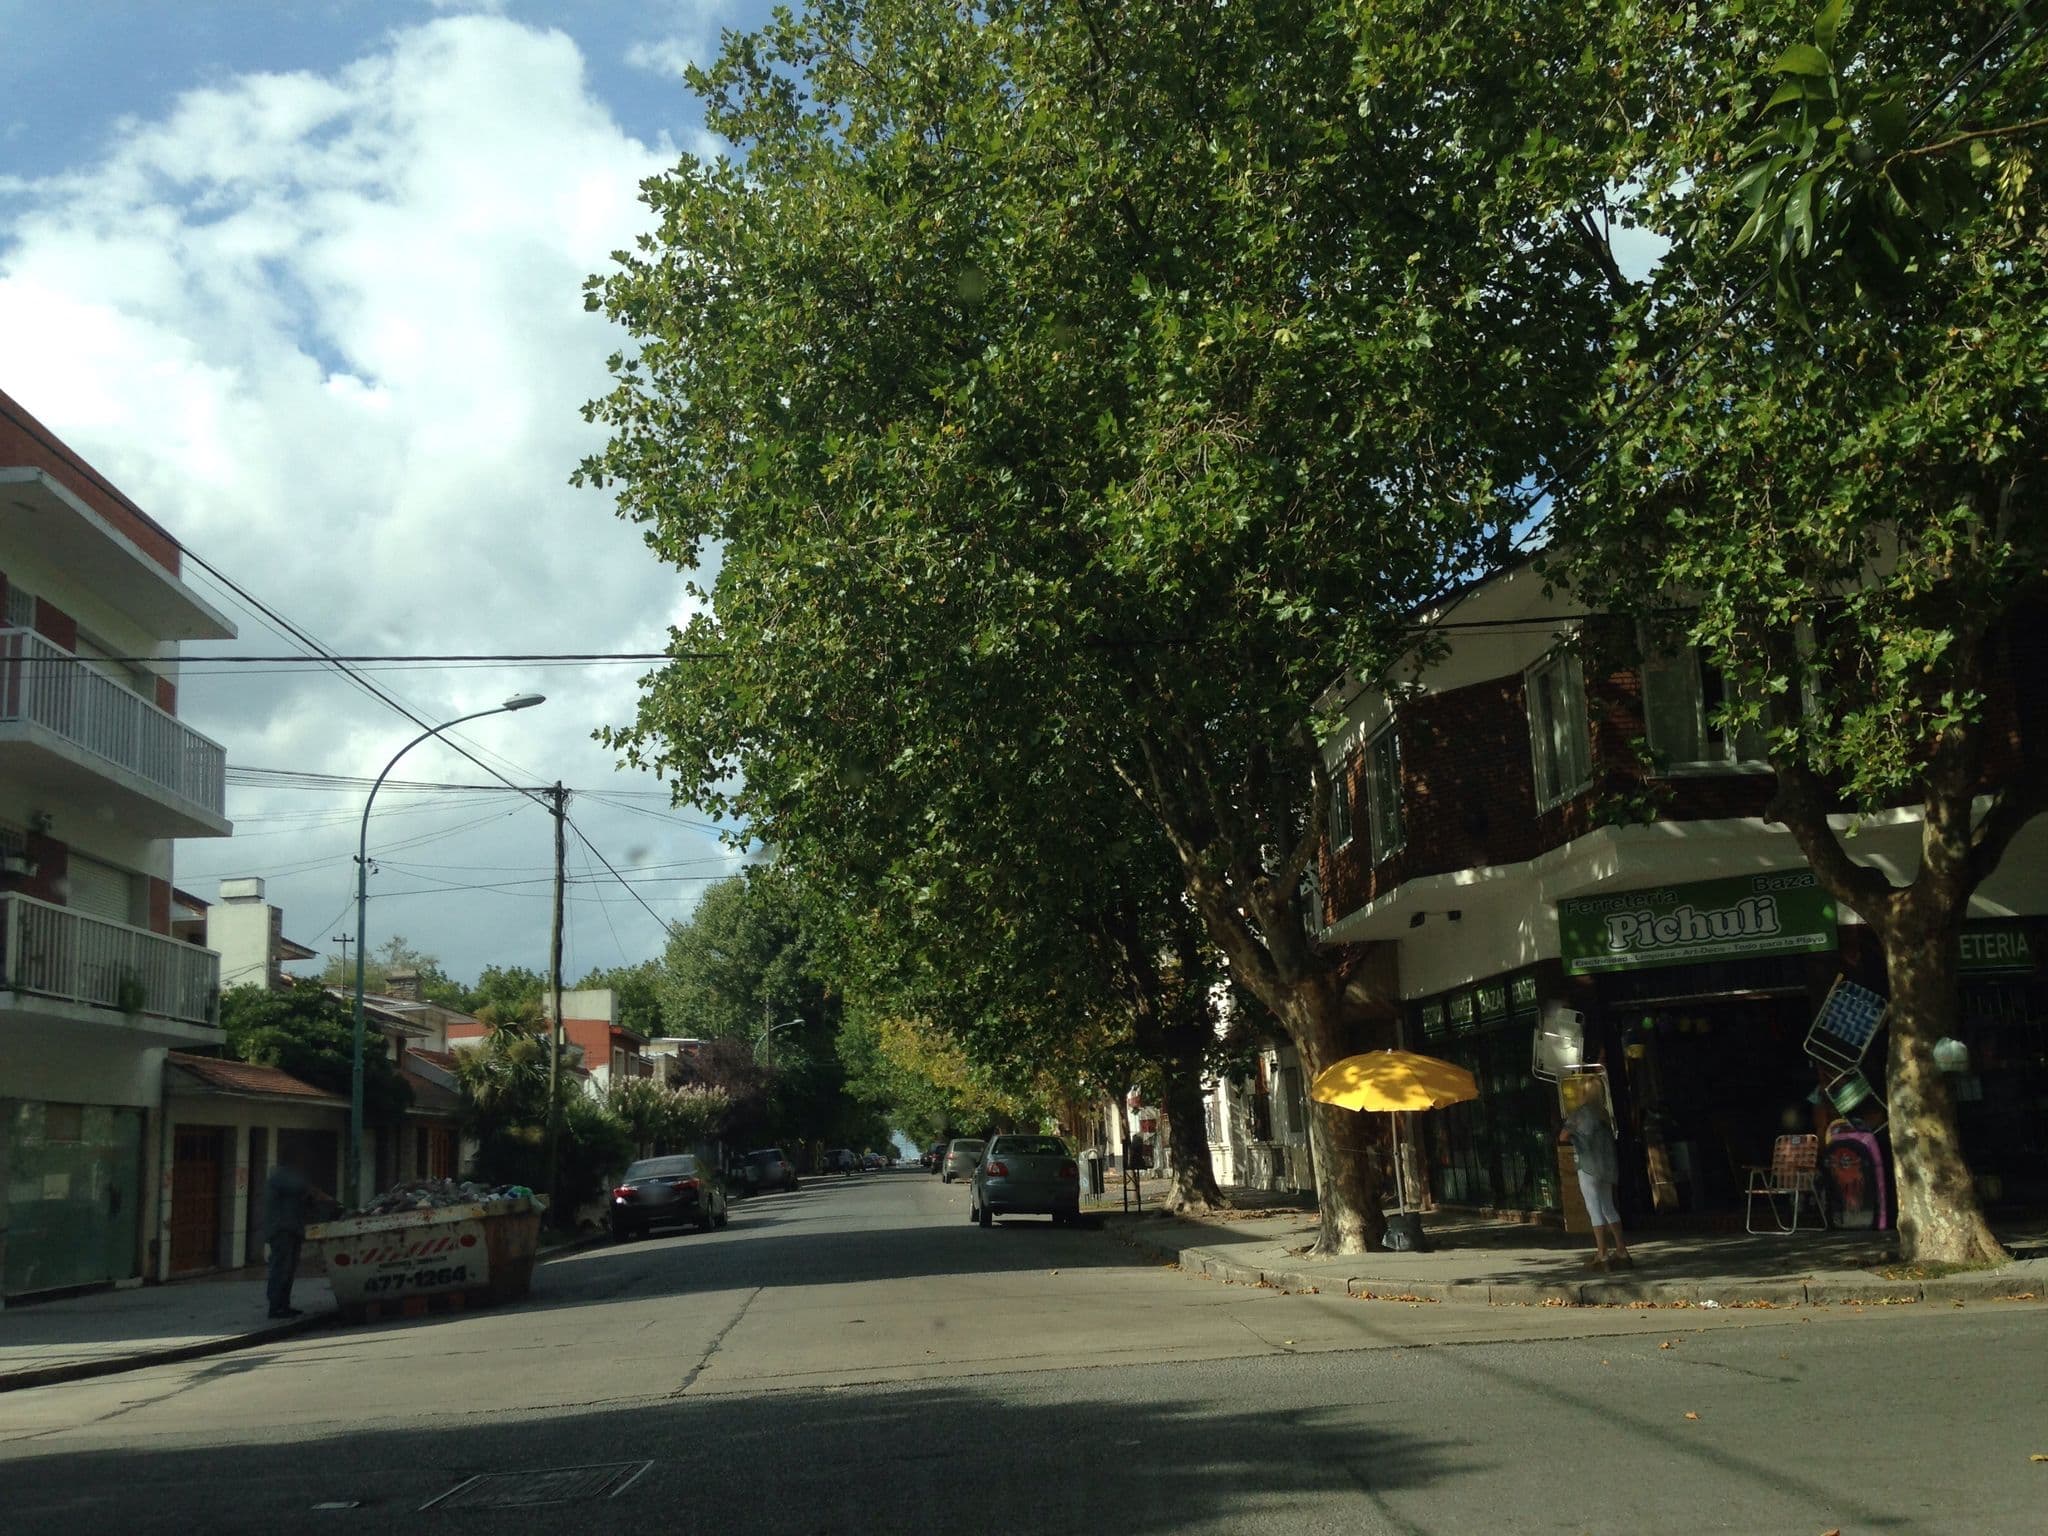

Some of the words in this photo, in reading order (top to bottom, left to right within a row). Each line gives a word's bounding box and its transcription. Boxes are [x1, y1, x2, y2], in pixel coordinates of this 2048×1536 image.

[1752, 873, 1816, 893] Baza
[1605, 896, 1781, 951] Pichuli
[1959, 932, 2030, 960] ETERIA
